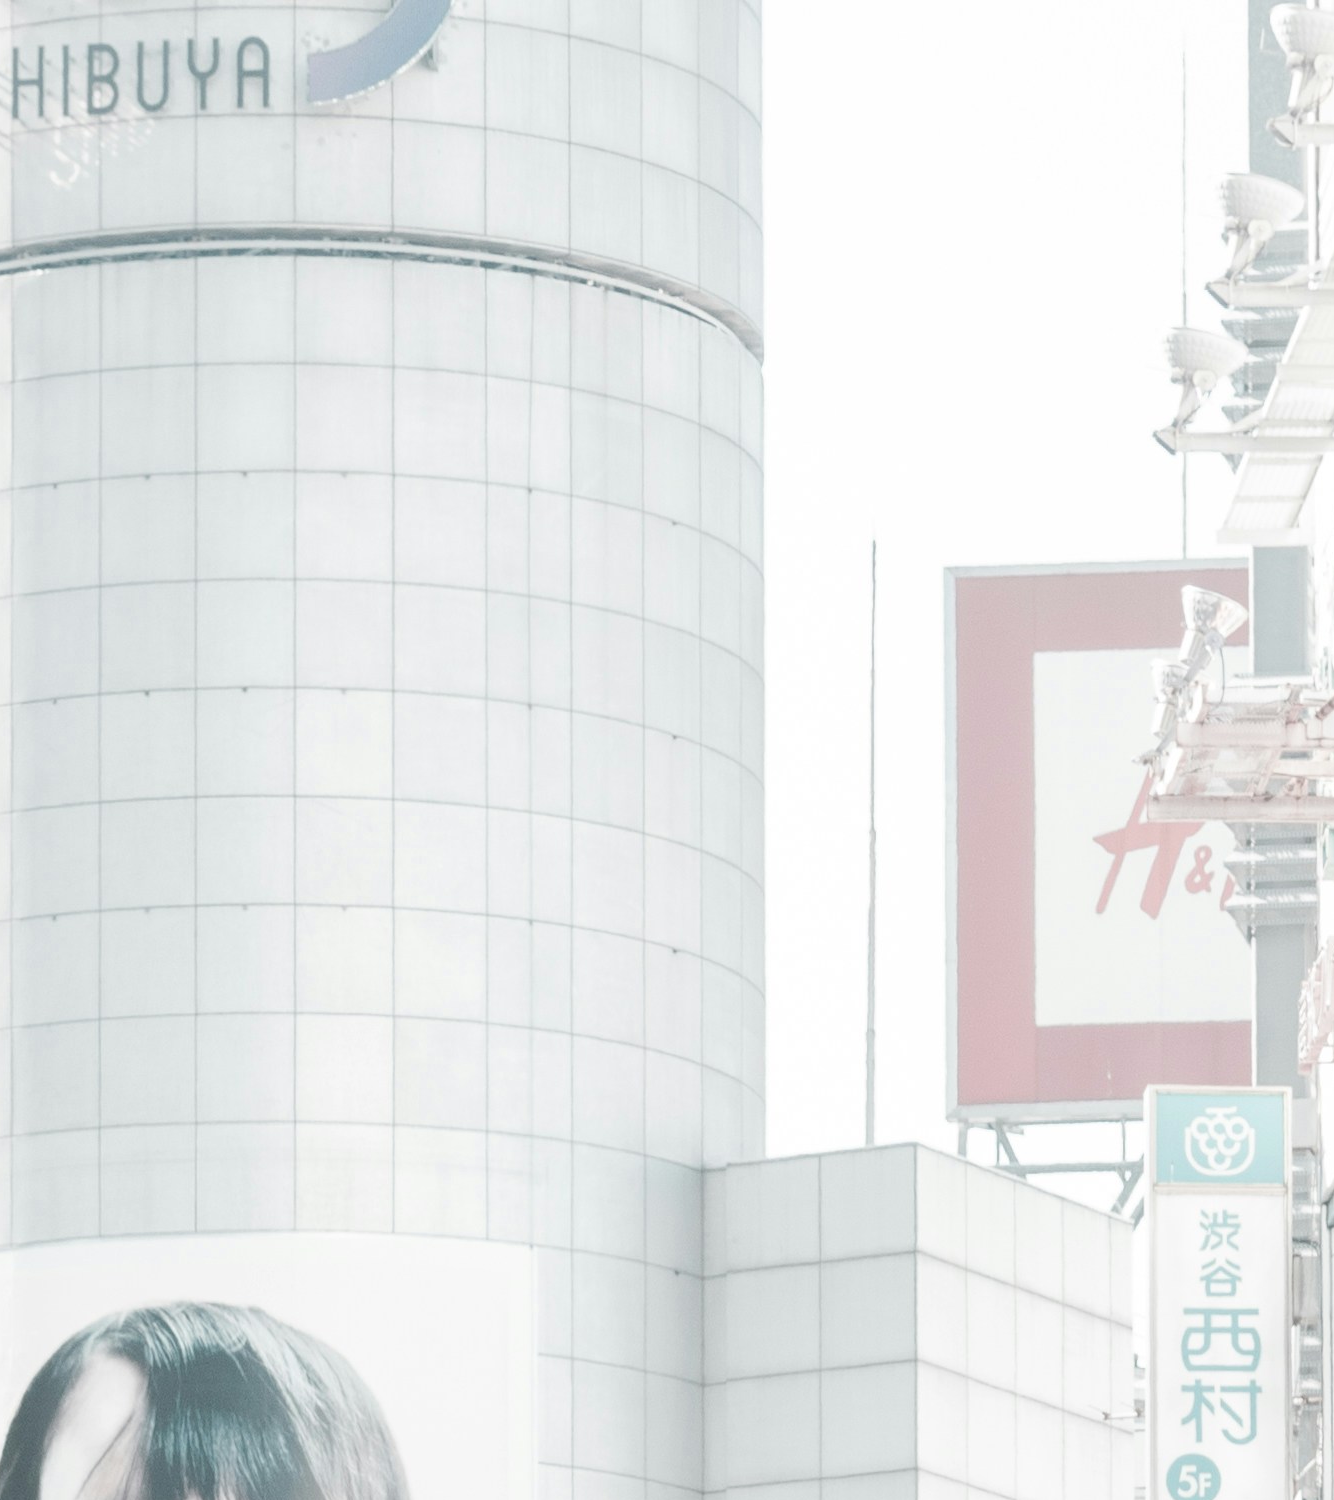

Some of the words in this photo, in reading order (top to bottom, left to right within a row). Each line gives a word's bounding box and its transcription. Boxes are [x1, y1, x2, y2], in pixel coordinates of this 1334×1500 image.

[1181, 1209, 1263, 1446] 渋谷西村
[1177, 1464, 1212, 1499] 5F
